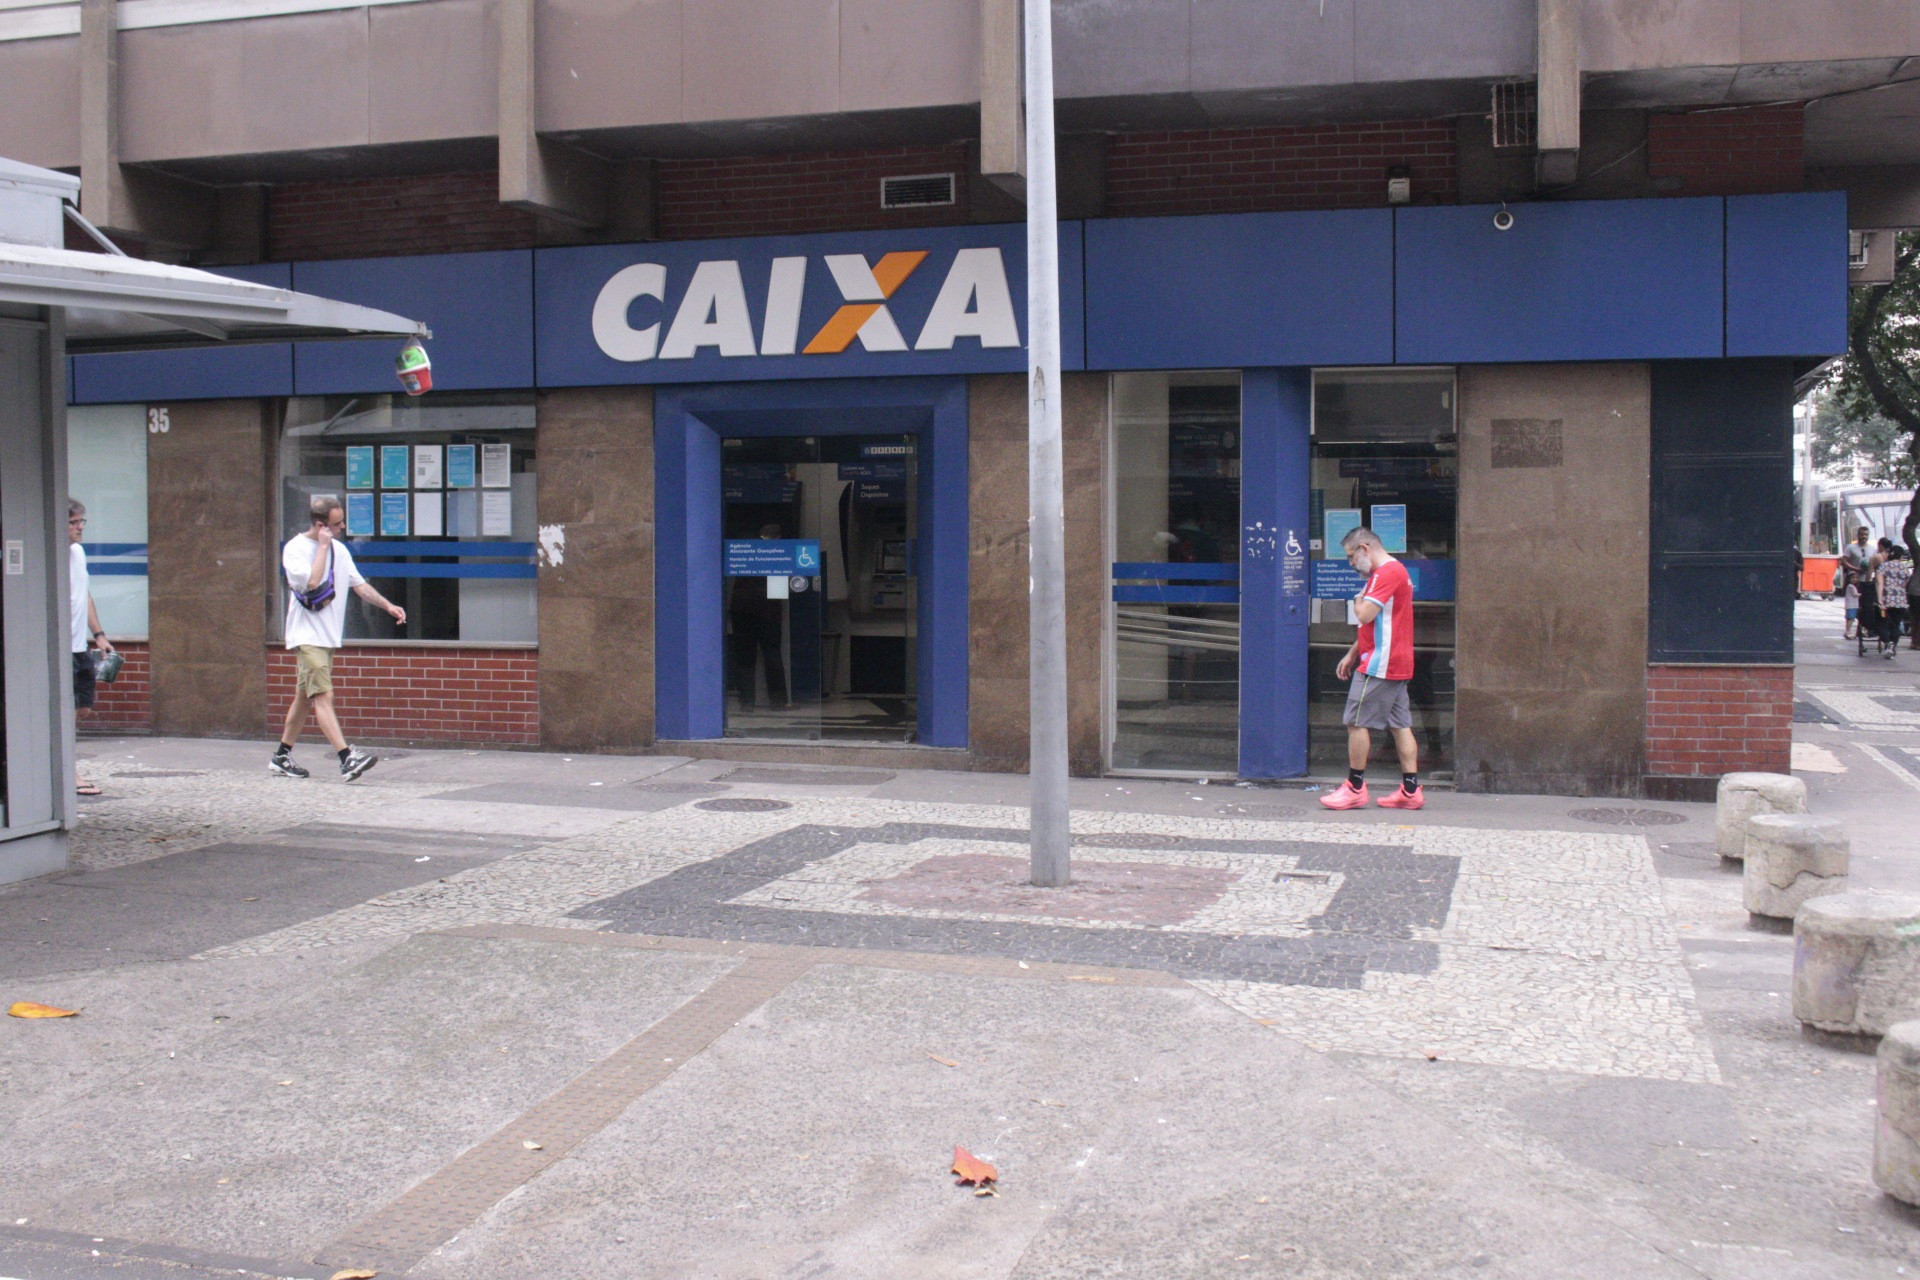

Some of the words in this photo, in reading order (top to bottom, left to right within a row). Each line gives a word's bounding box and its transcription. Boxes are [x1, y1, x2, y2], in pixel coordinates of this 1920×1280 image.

[592, 247, 1021, 362] CAIXA
[149, 408, 170, 433] 35
[860, 491, 888, 499] Depósitos
[861, 484, 880, 492] Saques
